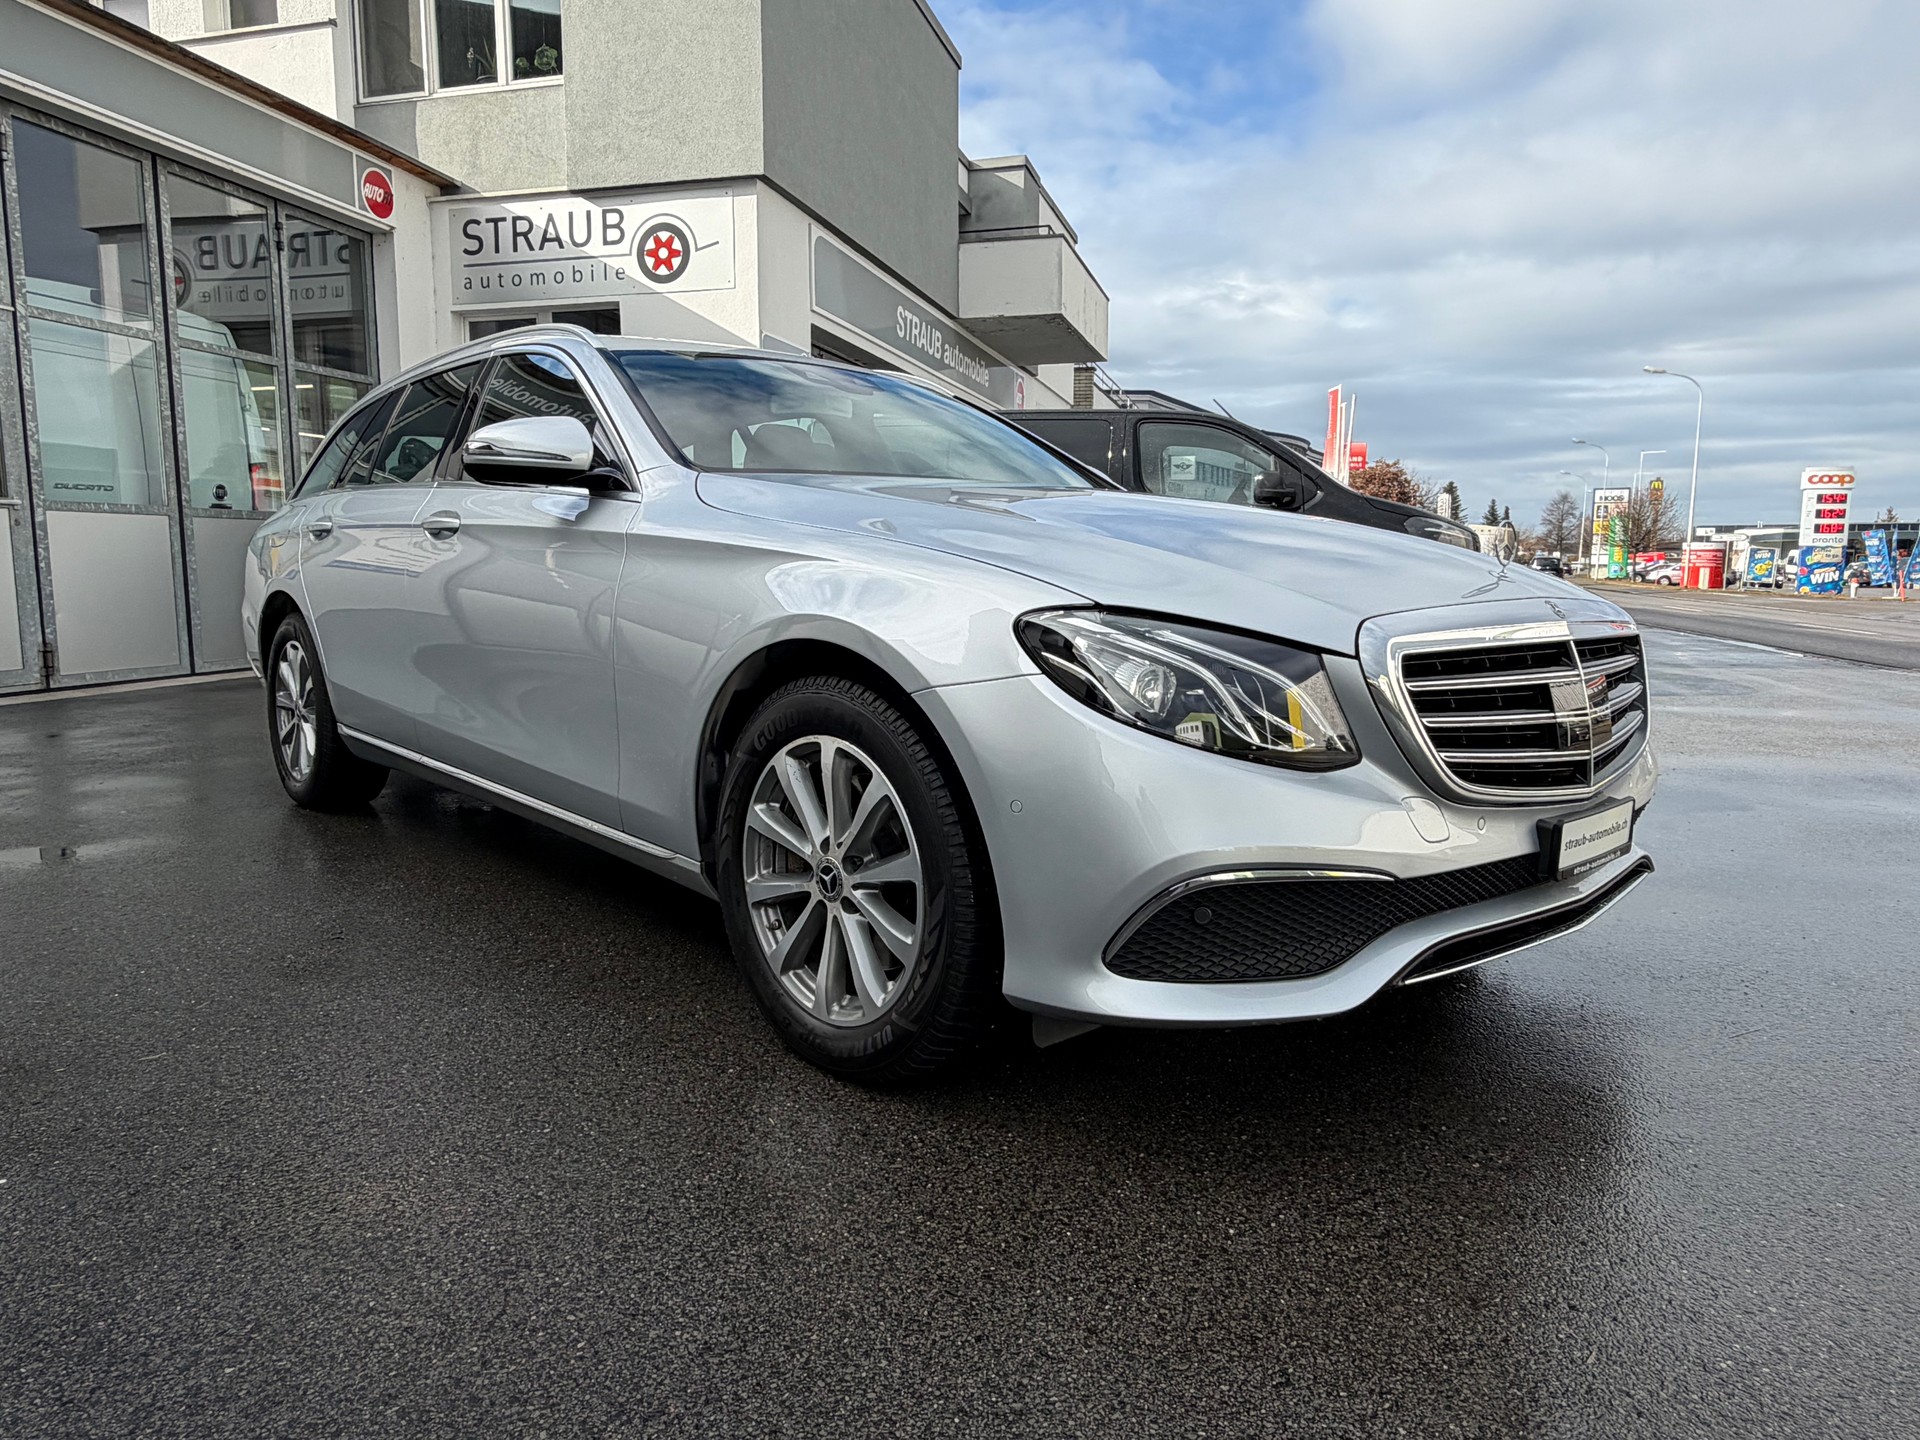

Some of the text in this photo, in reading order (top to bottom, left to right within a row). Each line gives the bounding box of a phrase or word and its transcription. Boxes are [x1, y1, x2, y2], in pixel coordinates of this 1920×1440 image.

[462, 208, 626, 256] STRAUB
[463, 264, 626, 290] automobile
[896, 305, 990, 388] STRAUB automobile
[53, 482, 114, 492] DUCATO
[1808, 474, 1855, 486] coop
[1810, 570, 1840, 585] WIN
[1564, 817, 1628, 851] straub-automobile.ch
